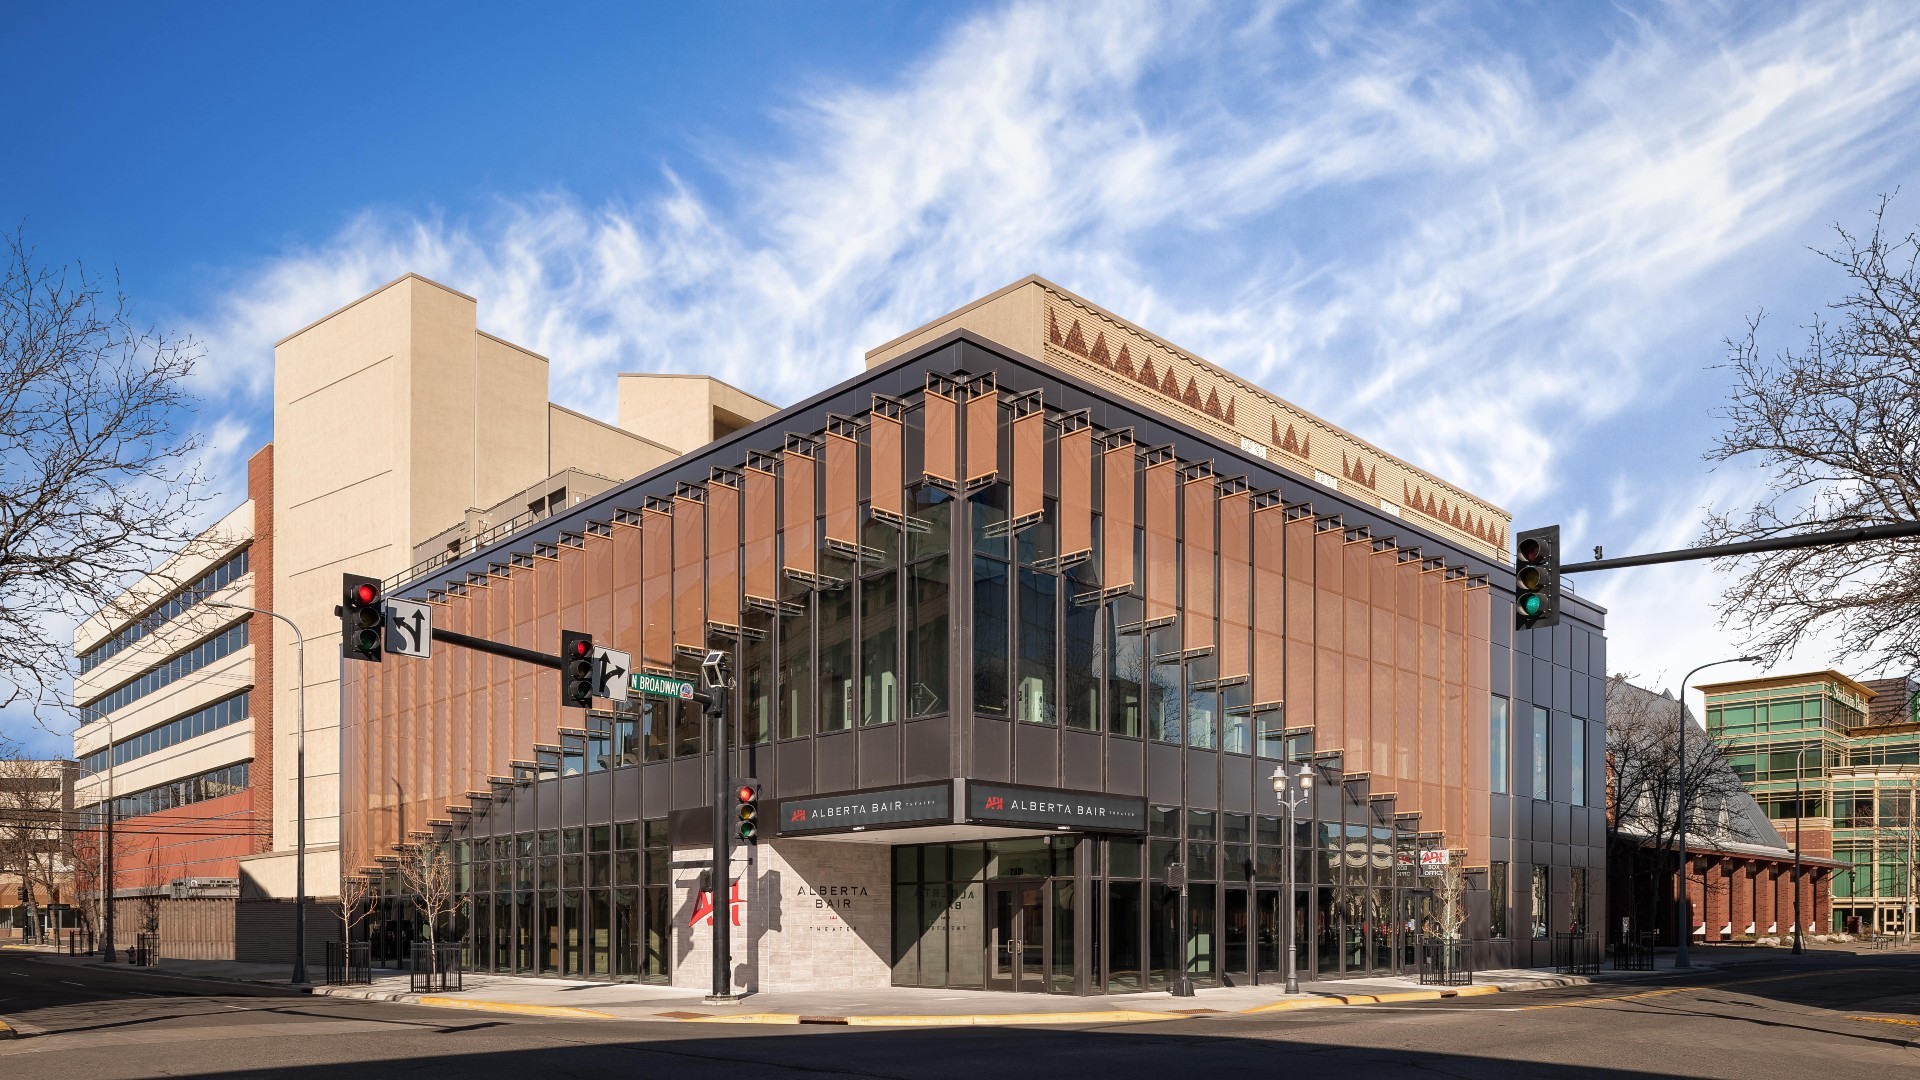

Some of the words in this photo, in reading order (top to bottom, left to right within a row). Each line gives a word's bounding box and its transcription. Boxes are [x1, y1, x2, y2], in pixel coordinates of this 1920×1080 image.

[631, 674, 638, 688] N
[640, 676, 680, 696] BROADWAY
[811, 804, 866, 819] ALBERTA
[871, 800, 902, 813] BAIR
[1010, 799, 1072, 815] ALBERTA
[1077, 805, 1106, 817] BAIR
[797, 885, 869, 896] ALBERTA
[815, 899, 851, 909] BAIR
